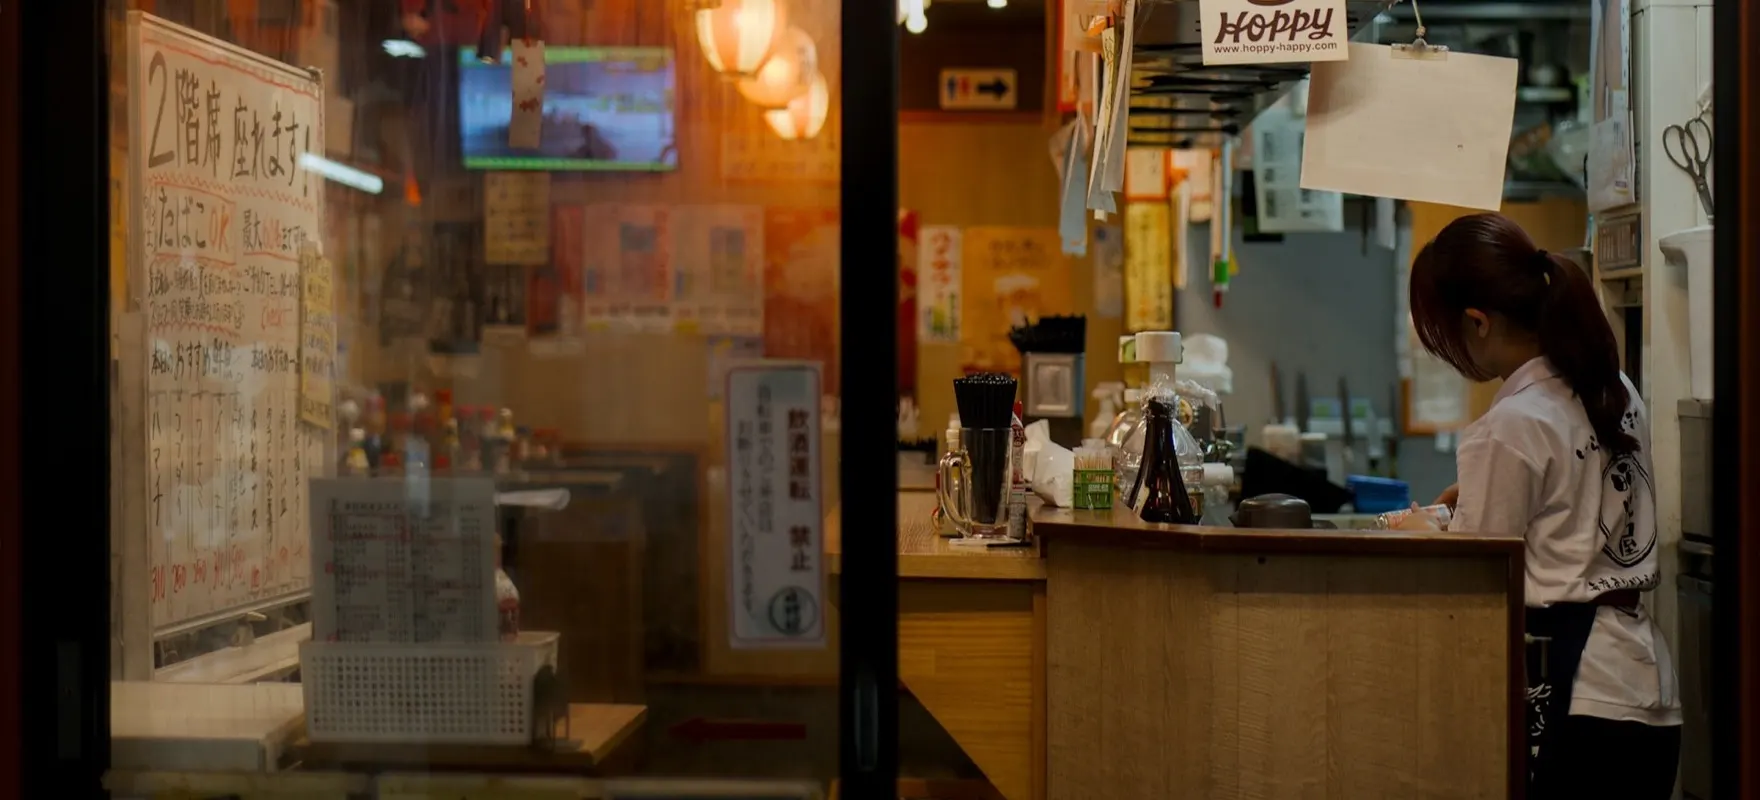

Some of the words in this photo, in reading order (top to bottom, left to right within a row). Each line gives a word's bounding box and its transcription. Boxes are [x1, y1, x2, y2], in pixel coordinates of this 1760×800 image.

[1213, 41, 1338, 54] www.hoppy-happy.com
[148, 50, 221, 178] 2階席
[158, 185, 207, 250] たばこ
[208, 203, 230, 254] OK
[152, 410, 164, 527] ハマチ
[788, 407, 812, 501] 飲酒運転
[789, 527, 812, 572] 禁止
